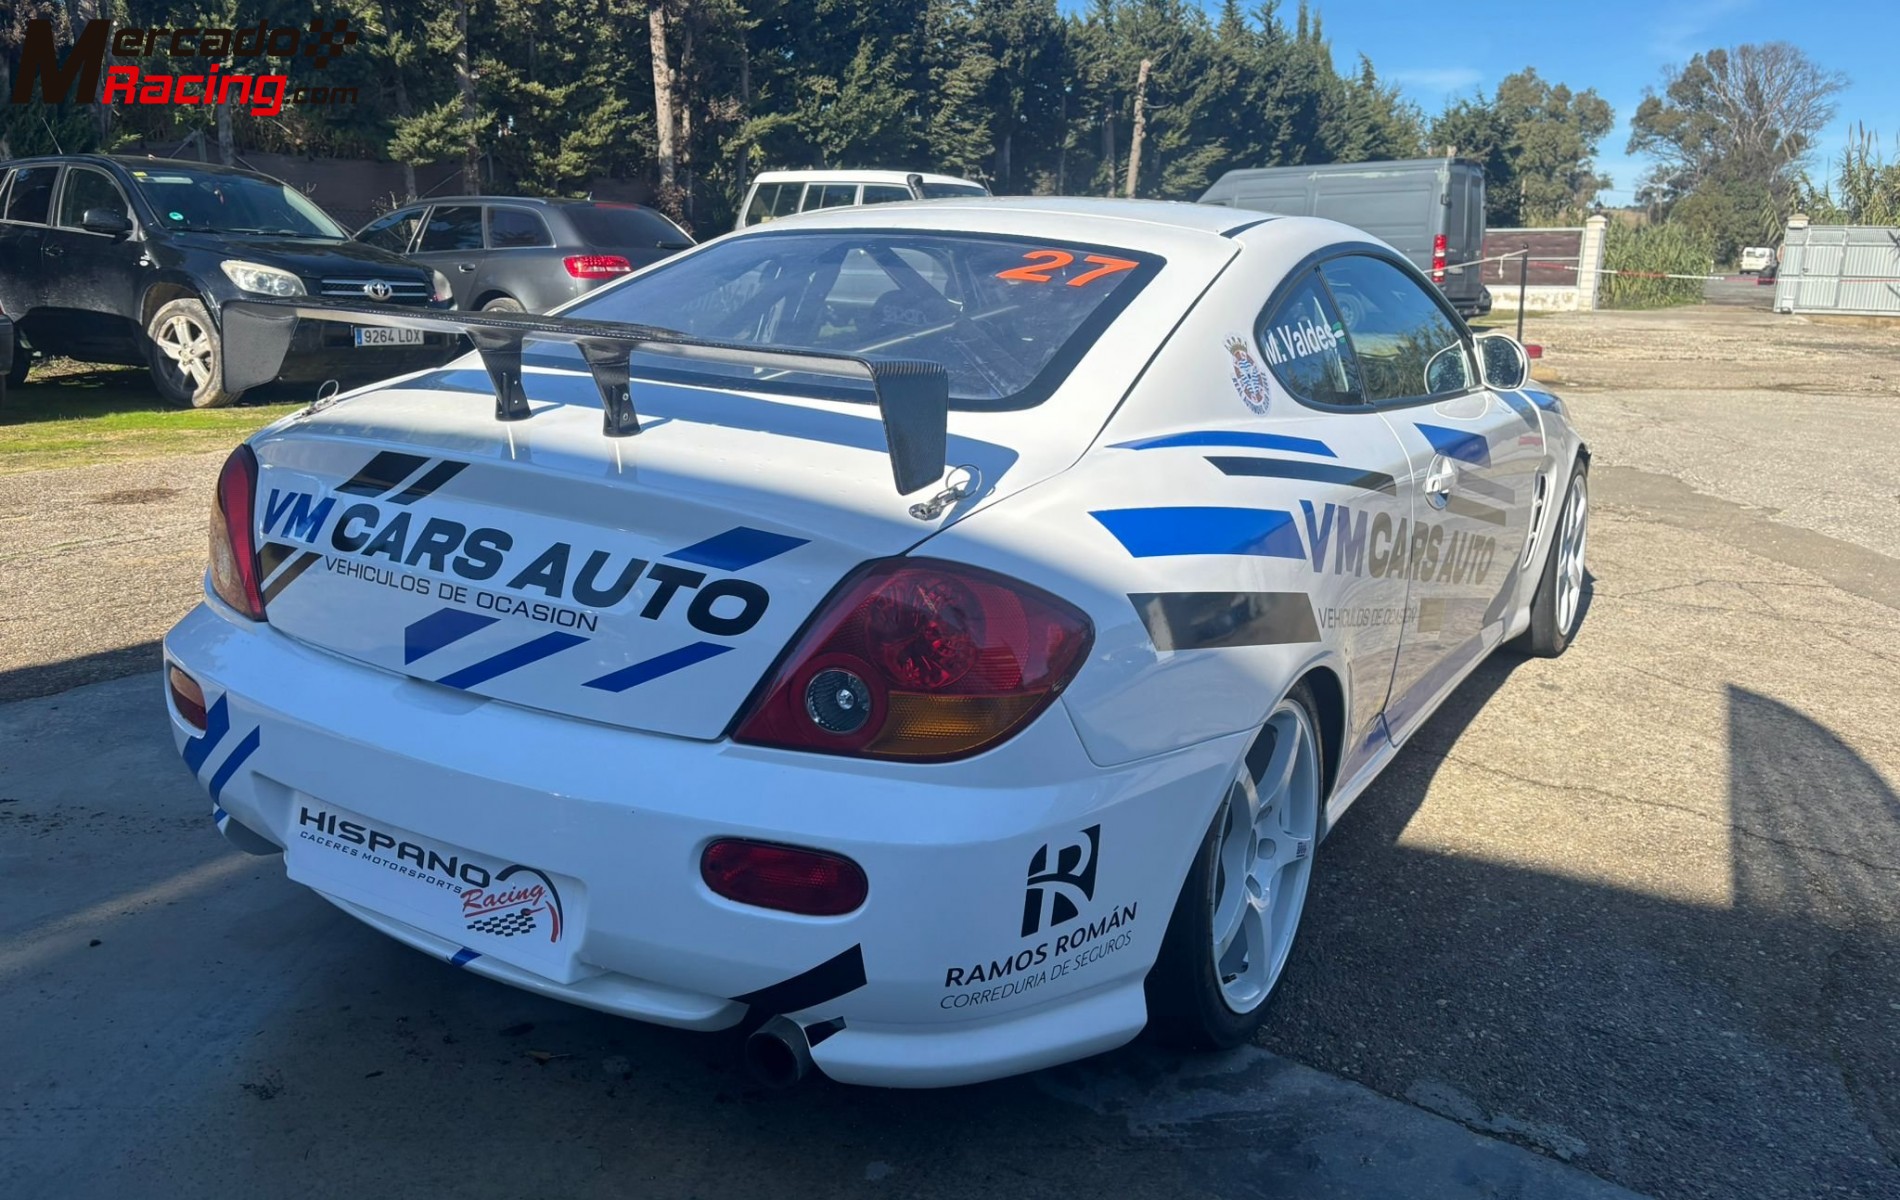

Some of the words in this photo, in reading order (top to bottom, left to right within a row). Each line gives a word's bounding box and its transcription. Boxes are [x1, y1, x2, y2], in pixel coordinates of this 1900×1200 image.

[995, 250, 1140, 287] 27
[364, 328, 395, 344] 9264
[398, 327, 421, 343] LDX
[505, 541, 770, 636] AUTO
[1436, 530, 1496, 586] AUTO
[325, 555, 431, 594] VEHICULOS
[438, 582, 468, 604] DE
[476, 590, 598, 632] OCASION
[299, 806, 490, 888] HISPANO
[300, 831, 358, 856] CACERES
[361, 852, 463, 894] MOTORSPORTS
[461, 884, 546, 912] Racing
[940, 970, 1047, 1009] CORREDURIA
[1050, 960, 1073, 981] DE
[1072, 930, 1132, 971] SEGUROS
[945, 943, 1048, 987] RAMOS
[1055, 901, 1137, 957] ROMÁN
